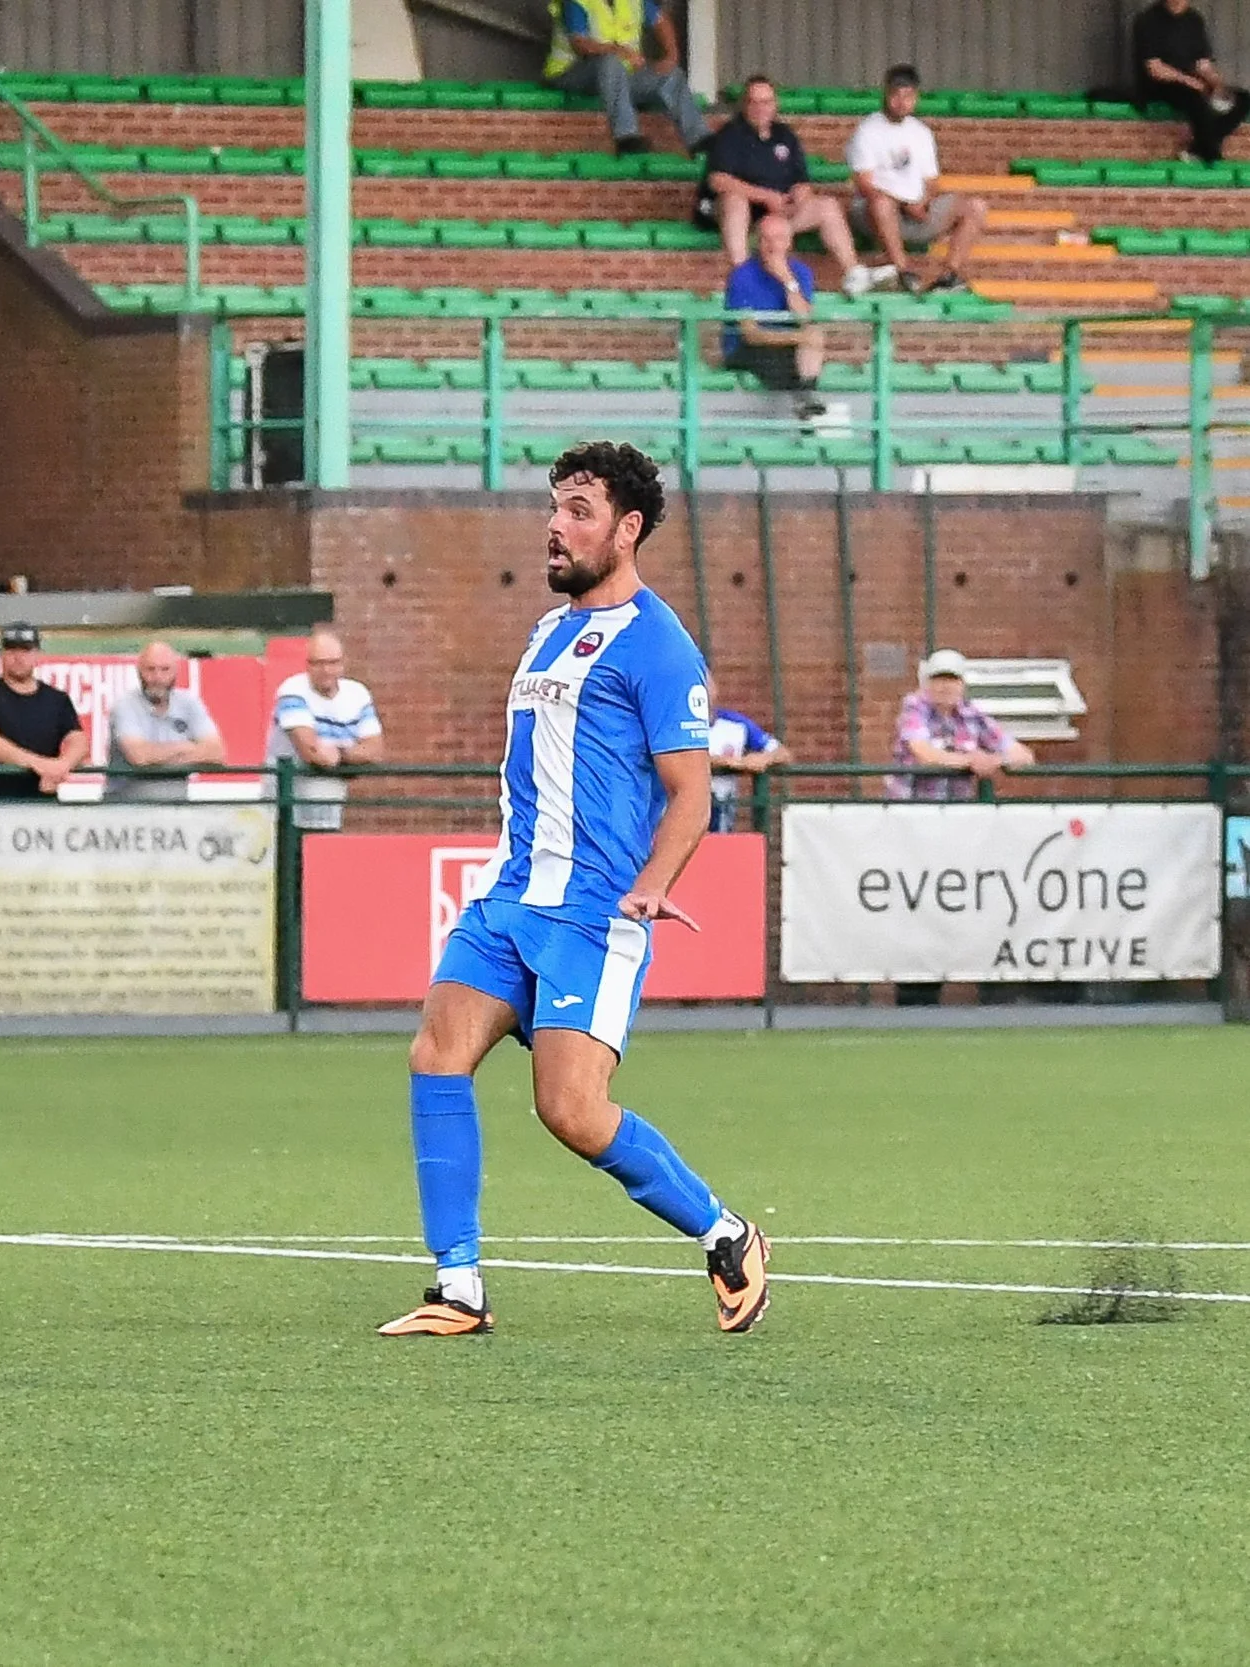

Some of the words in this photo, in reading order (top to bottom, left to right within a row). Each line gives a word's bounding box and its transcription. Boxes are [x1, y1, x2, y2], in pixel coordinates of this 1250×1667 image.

[12, 826, 54, 852] ON
[65, 826, 188, 852] CAMERA
[858, 831, 1148, 927] everyone
[994, 936, 1148, 968] ACTIVE
